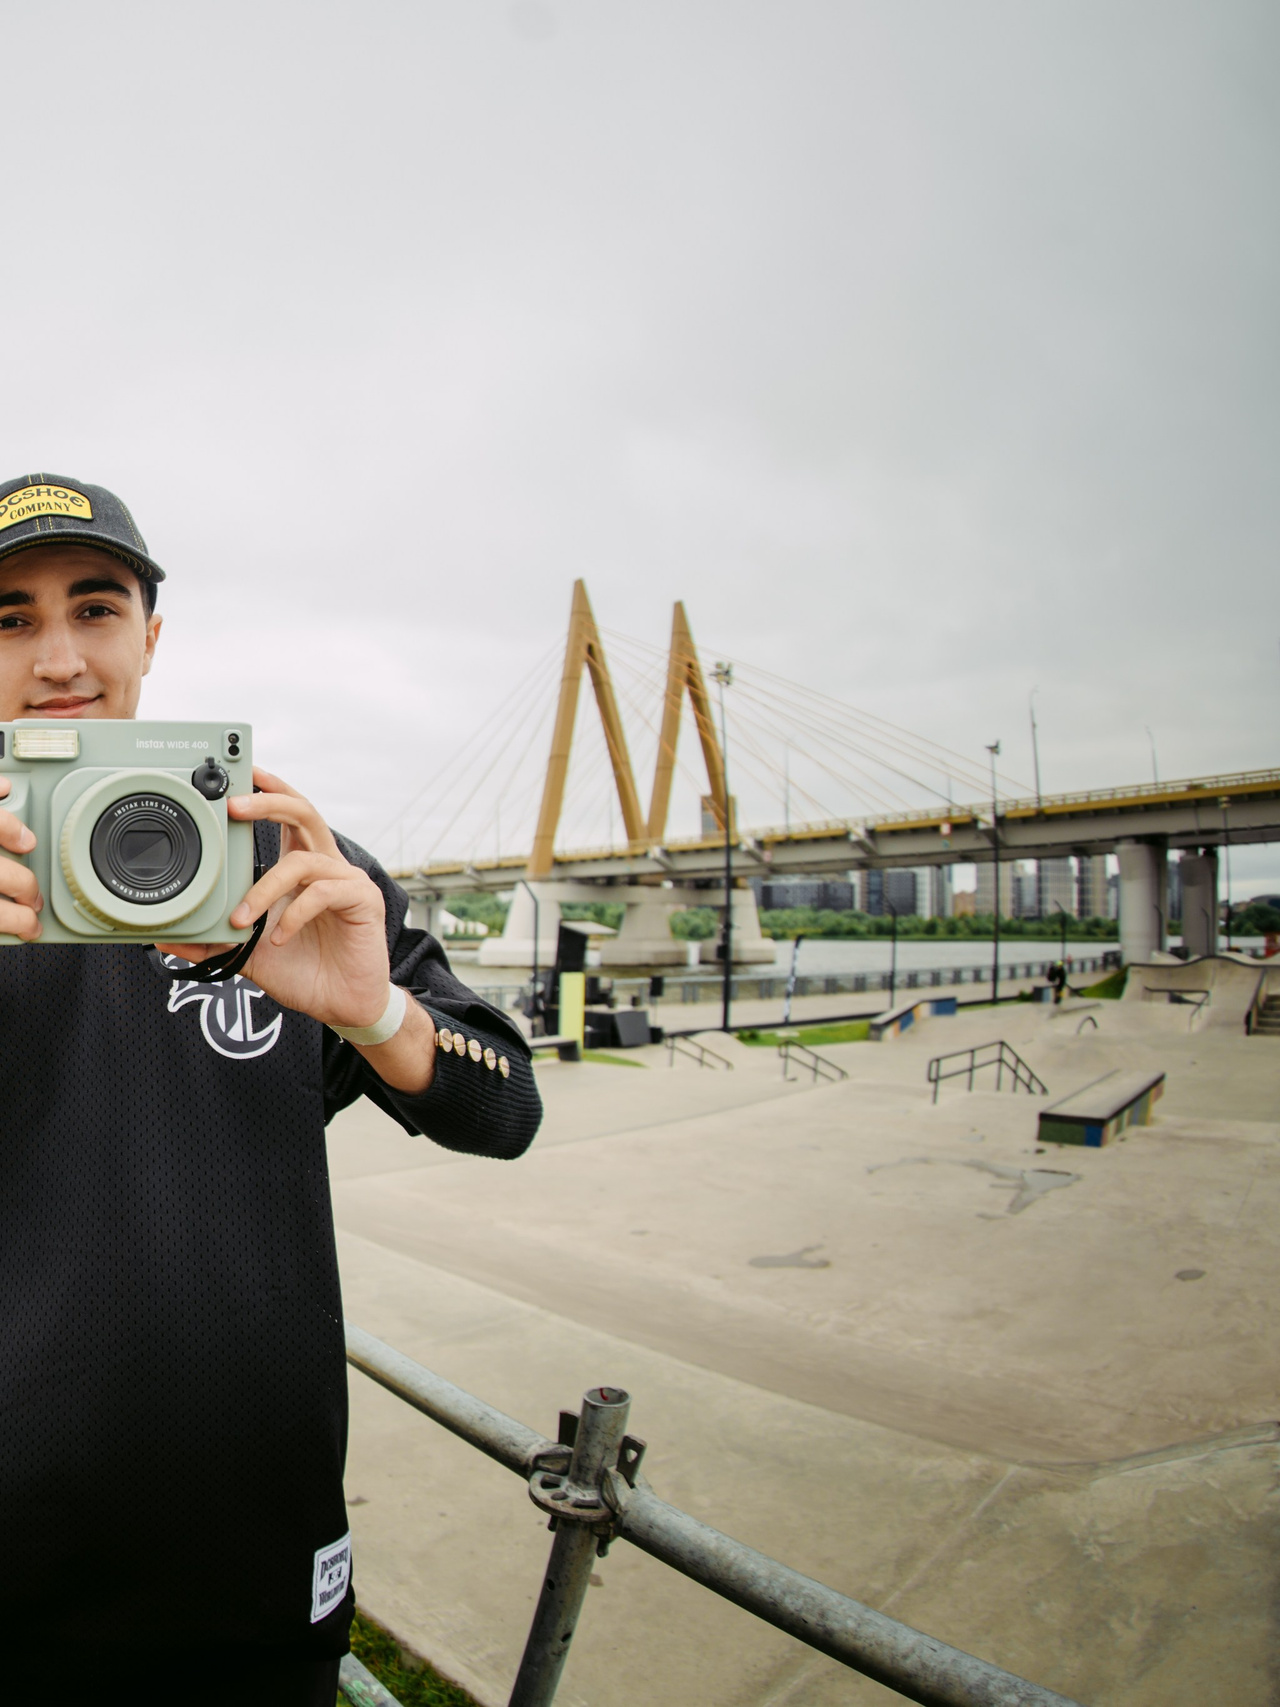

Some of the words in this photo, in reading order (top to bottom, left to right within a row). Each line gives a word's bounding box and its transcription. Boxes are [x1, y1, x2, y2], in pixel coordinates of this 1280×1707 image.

[9, 501, 71, 520] COMPANY
[136, 738, 164, 749] instax
[166, 740, 190, 749] WIDE
[191, 740, 209, 749] 400
[114, 801, 139, 818] INSTAX
[141, 800, 159, 808] LENS
[161, 803, 178, 818] 95mm
[161, 879, 182, 895] FOCUS
